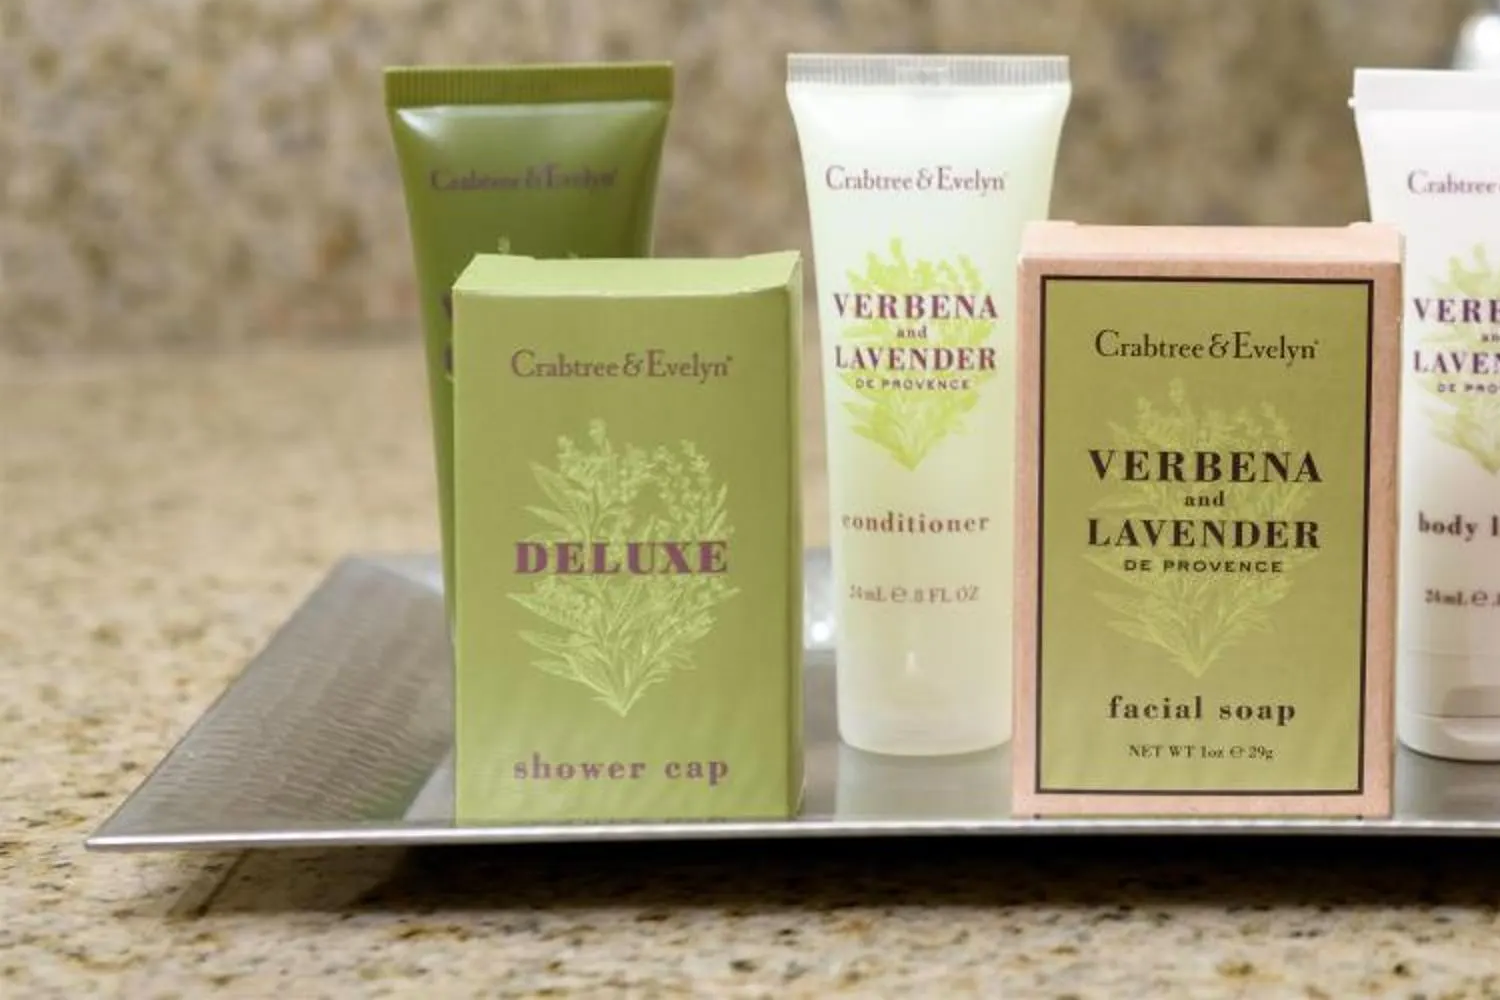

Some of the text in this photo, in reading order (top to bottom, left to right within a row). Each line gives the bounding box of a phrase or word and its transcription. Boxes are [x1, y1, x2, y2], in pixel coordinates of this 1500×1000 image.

[825, 165, 913, 191] Crabtree
[916, 167, 932, 191] &
[1408, 169, 1496, 195] Crabtree
[833, 292, 999, 320] VERBENA
[897, 325, 927, 339] and
[1095, 329, 1204, 359] Crabtree
[1209, 333, 1230, 359] &
[511, 349, 618, 378] Crabtree
[623, 351, 646, 377] &
[835, 345, 996, 371] LAVENDER
[855, 378, 970, 391] DE PROVENCE
[1438, 383, 1456, 393] DE
[1088, 449, 1323, 483] VERBENA
[1184, 491, 1225, 507] and
[841, 511, 990, 534] conditioner
[1087, 518, 1320, 548] LAVENDER
[1418, 510, 1477, 542] body
[514, 540, 728, 575] DELUXE
[1124, 559, 1283, 573] DE PROVENCE
[1109, 695, 1296, 726] facial soap
[1128, 745, 1162, 758] NET
[1169, 745, 1195, 758] WT
[1248, 745, 1274, 760] 29g
[513, 752, 729, 785] shower cap
